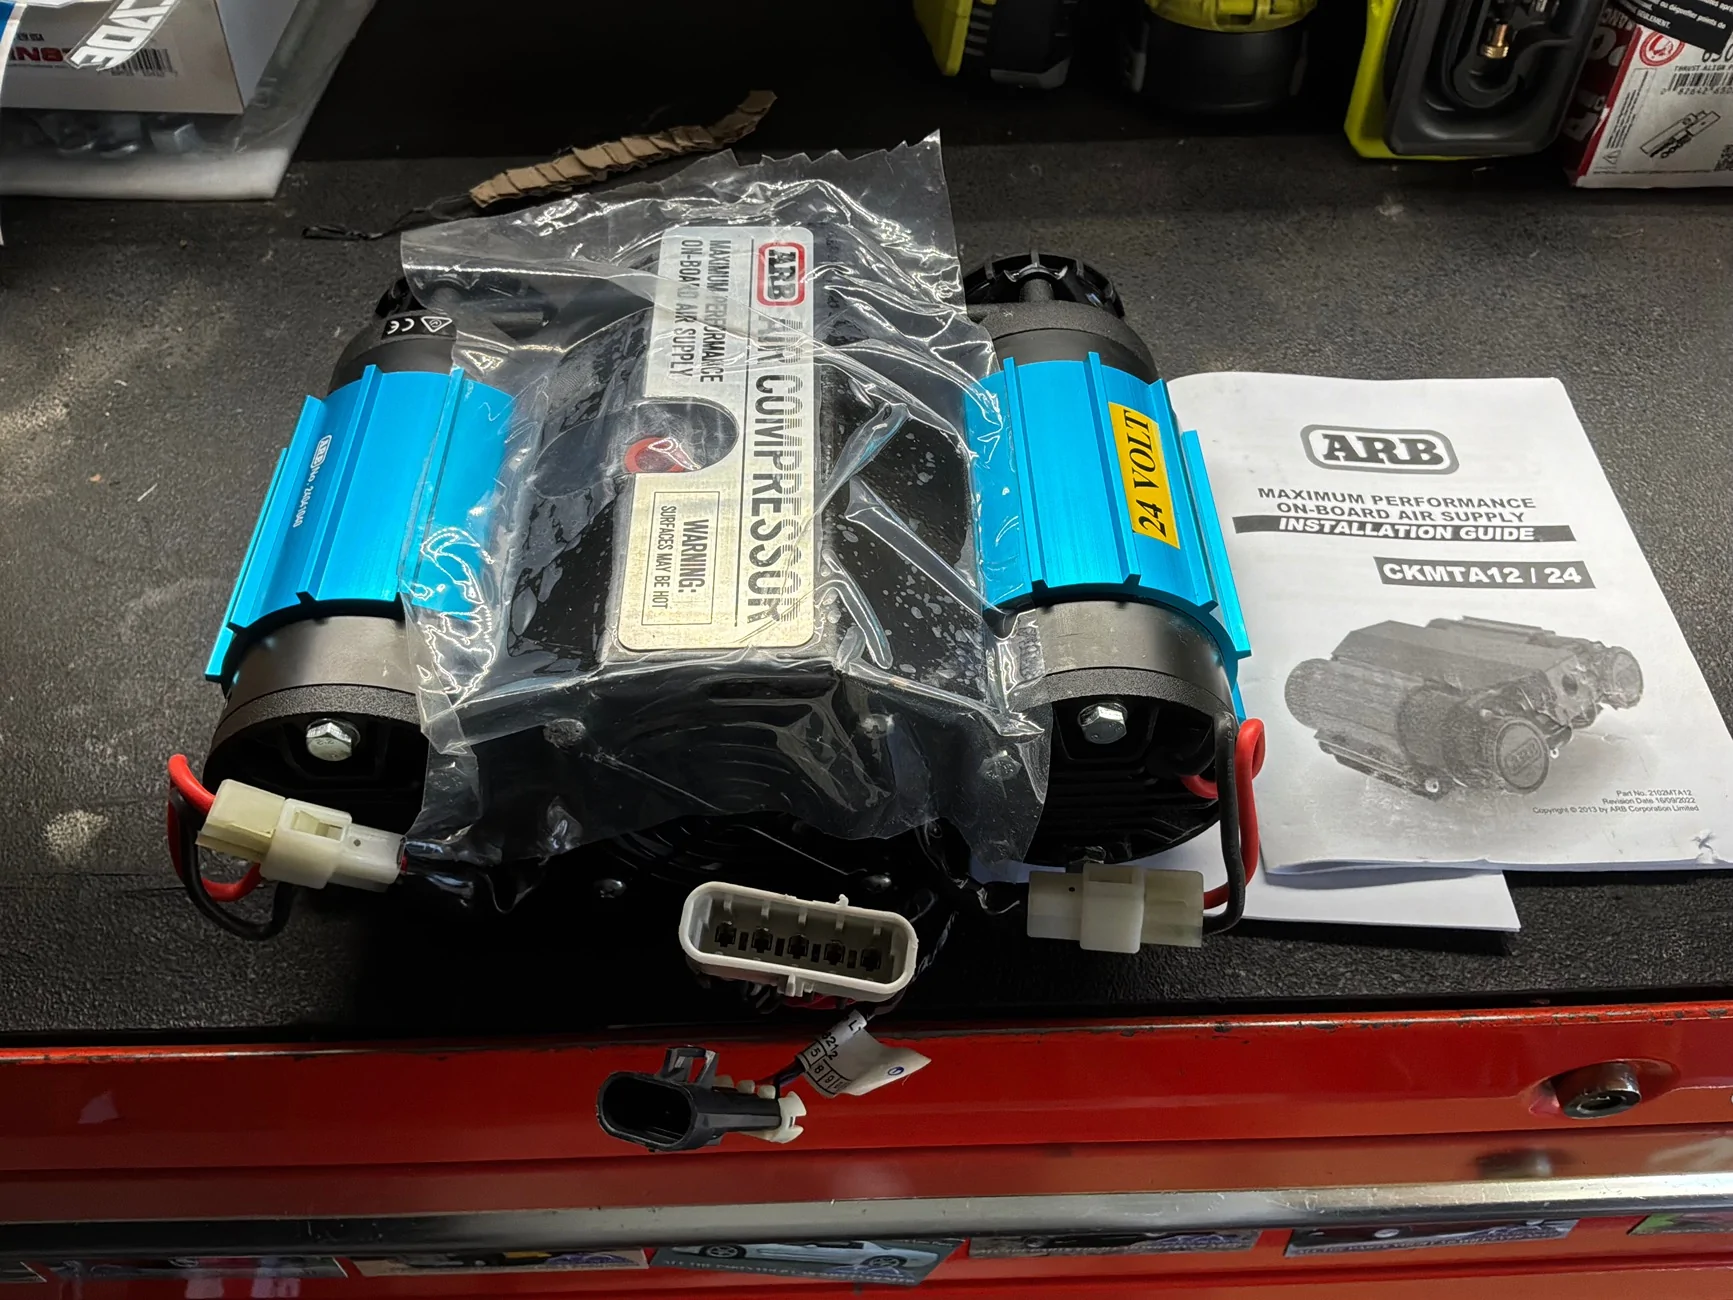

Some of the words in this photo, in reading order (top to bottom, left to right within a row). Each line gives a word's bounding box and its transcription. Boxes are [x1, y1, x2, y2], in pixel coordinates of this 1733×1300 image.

[706, 240, 731, 292] MAXIMUM
[768, 249, 797, 300] ARB
[674, 302, 699, 324] AIR
[669, 327, 697, 377] SUPPLY
[758, 315, 803, 363] AIR
[1123, 408, 1160, 489] VOLT
[1321, 433, 1445, 466] ARB
[747, 374, 804, 624] COMPRESSOR
[1257, 487, 1364, 505] MAXIMUM
[1371, 494, 1537, 510] PERFORMANCE
[1276, 502, 1389, 520] ON-BOARD
[1398, 511, 1437, 522] AIR
[1441, 511, 1524, 523] SUPPLY
[657, 505, 677, 551] SURFACES
[1135, 499, 1167, 538] 24
[1278, 517, 1453, 540] INSTALLATION
[1459, 526, 1536, 541] GUIDE
[655, 553, 673, 573] MAY
[678, 519, 709, 593] WARNING:
[653, 575, 671, 588] BE
[1382, 562, 1524, 584] CKMTA12
[1543, 566, 1583, 584] 24
[651, 590, 670, 610] HOT
[1616, 789, 1633, 797] Part
[1634, 789, 1647, 797] No.
[1532, 806, 1570, 815] Copyright
[1578, 806, 1598, 814] 2013
[1599, 806, 1608, 815] by
[1610, 805, 1627, 813] ARB
[1628, 804, 1672, 813] Corporation
[1673, 804, 1700, 813] Limited
